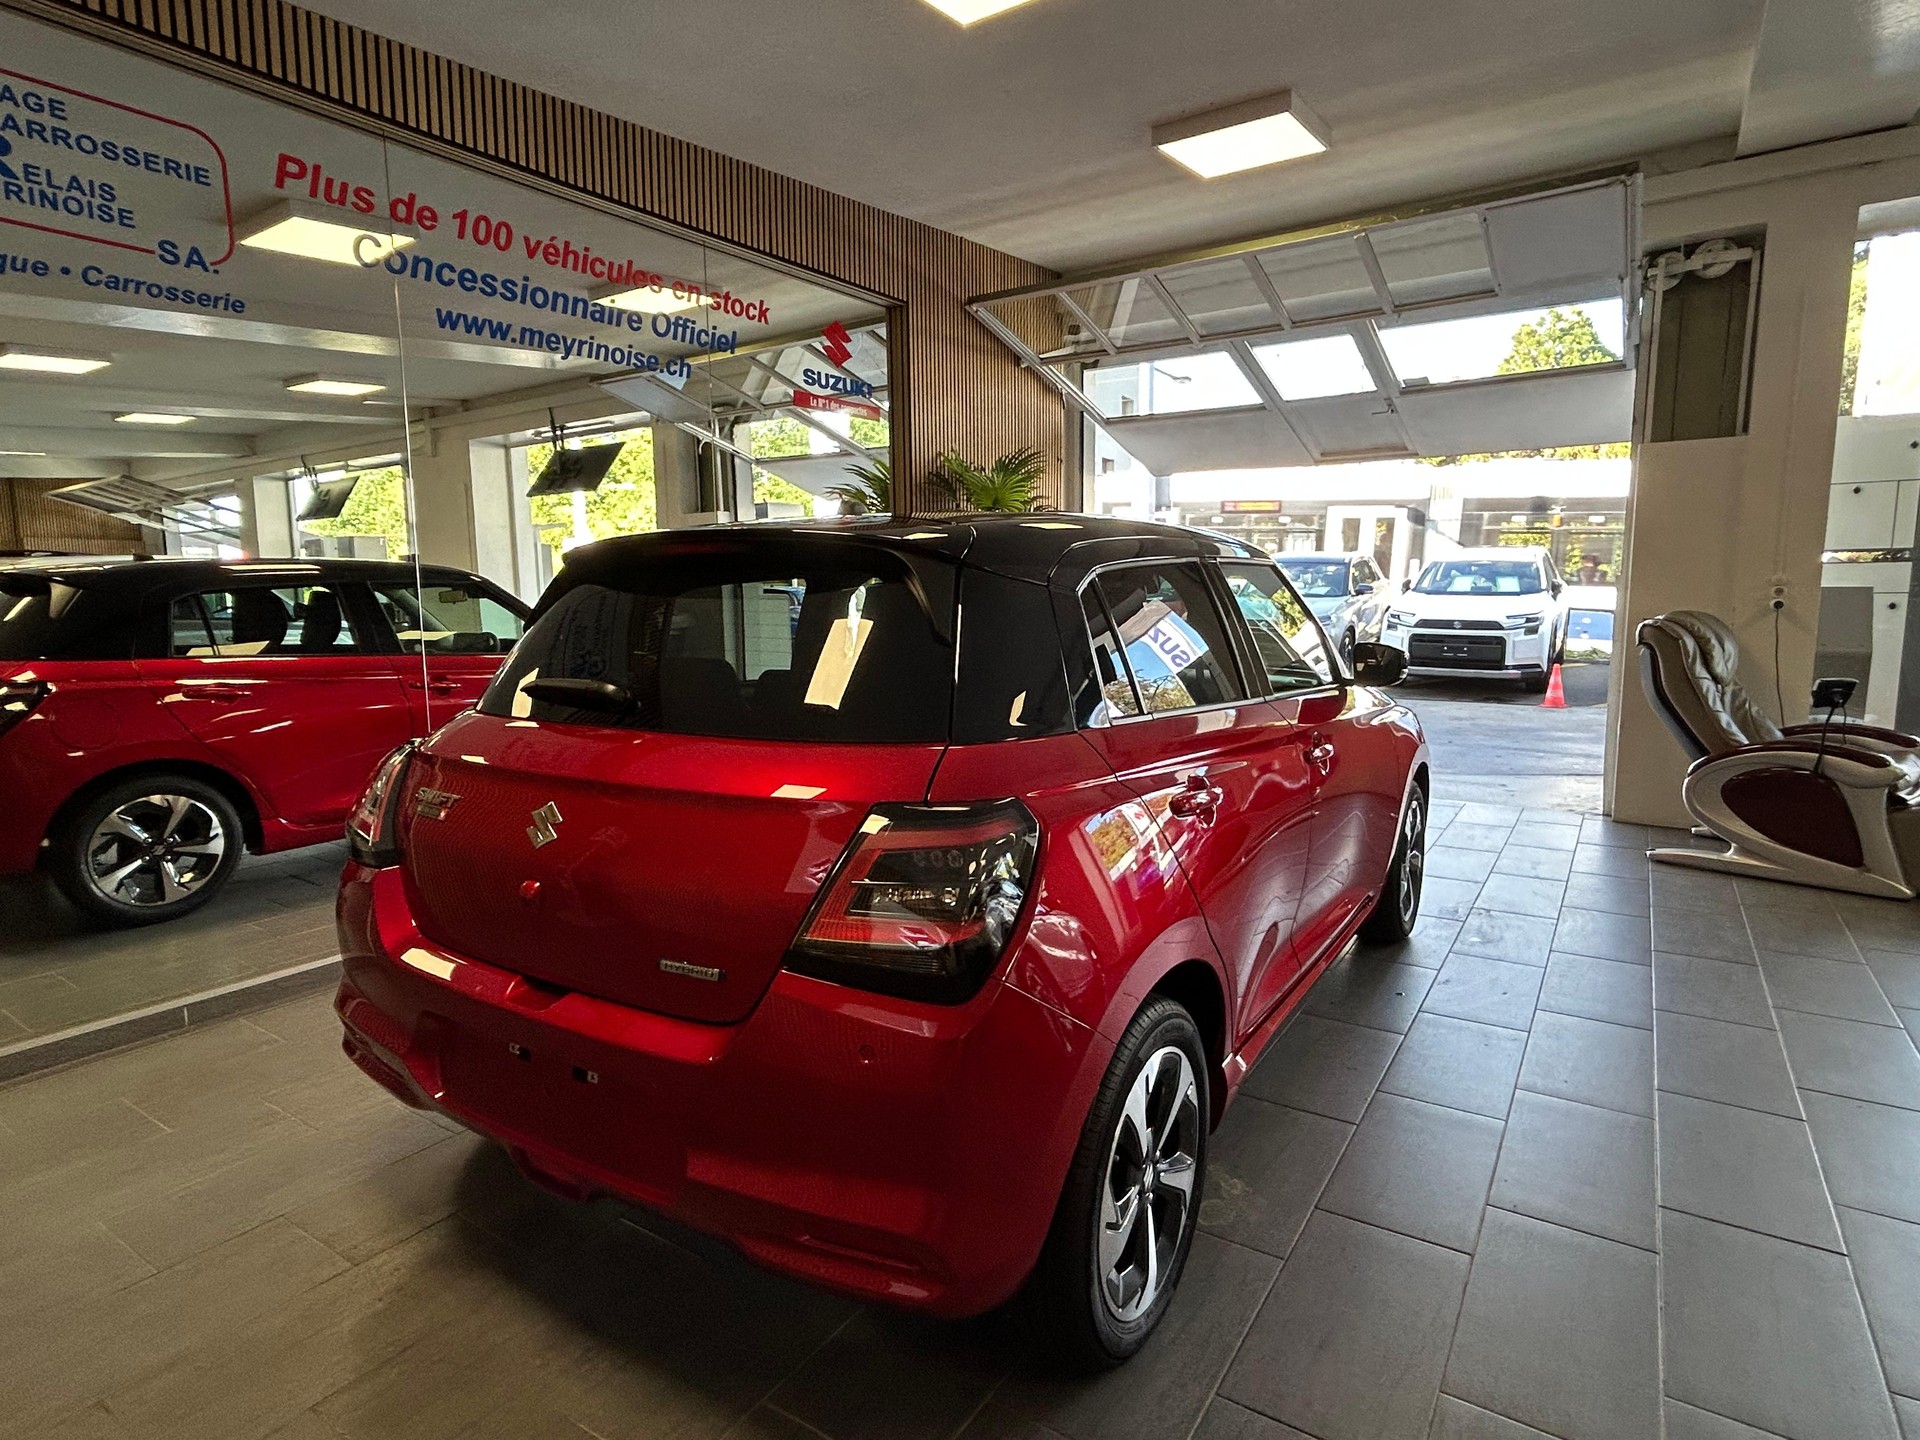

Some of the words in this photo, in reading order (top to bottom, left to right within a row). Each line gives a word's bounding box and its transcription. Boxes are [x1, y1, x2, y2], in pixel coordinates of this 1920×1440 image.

[0, 84, 68, 121] AGE
[0, 114, 212, 186] ARROSSERIE
[3, 181, 136, 229] RINOISE
[158, 239, 219, 275] SA.
[274, 153, 375, 214] Plus
[390, 193, 438, 232] de
[452, 209, 513, 252] 100
[524, 236, 662, 293] véhicules
[672, 277, 702, 307] en
[709, 285, 771, 325] stock
[81, 265, 246, 314] Carrosserie
[352, 234, 642, 332] Concessionnaire
[651, 311, 737, 355] Officiel
[436, 307, 692, 379] www.meyrinoise.ch
[802, 368, 873, 399] SUZUKI
[663, 962, 716, 979] HYBRID
